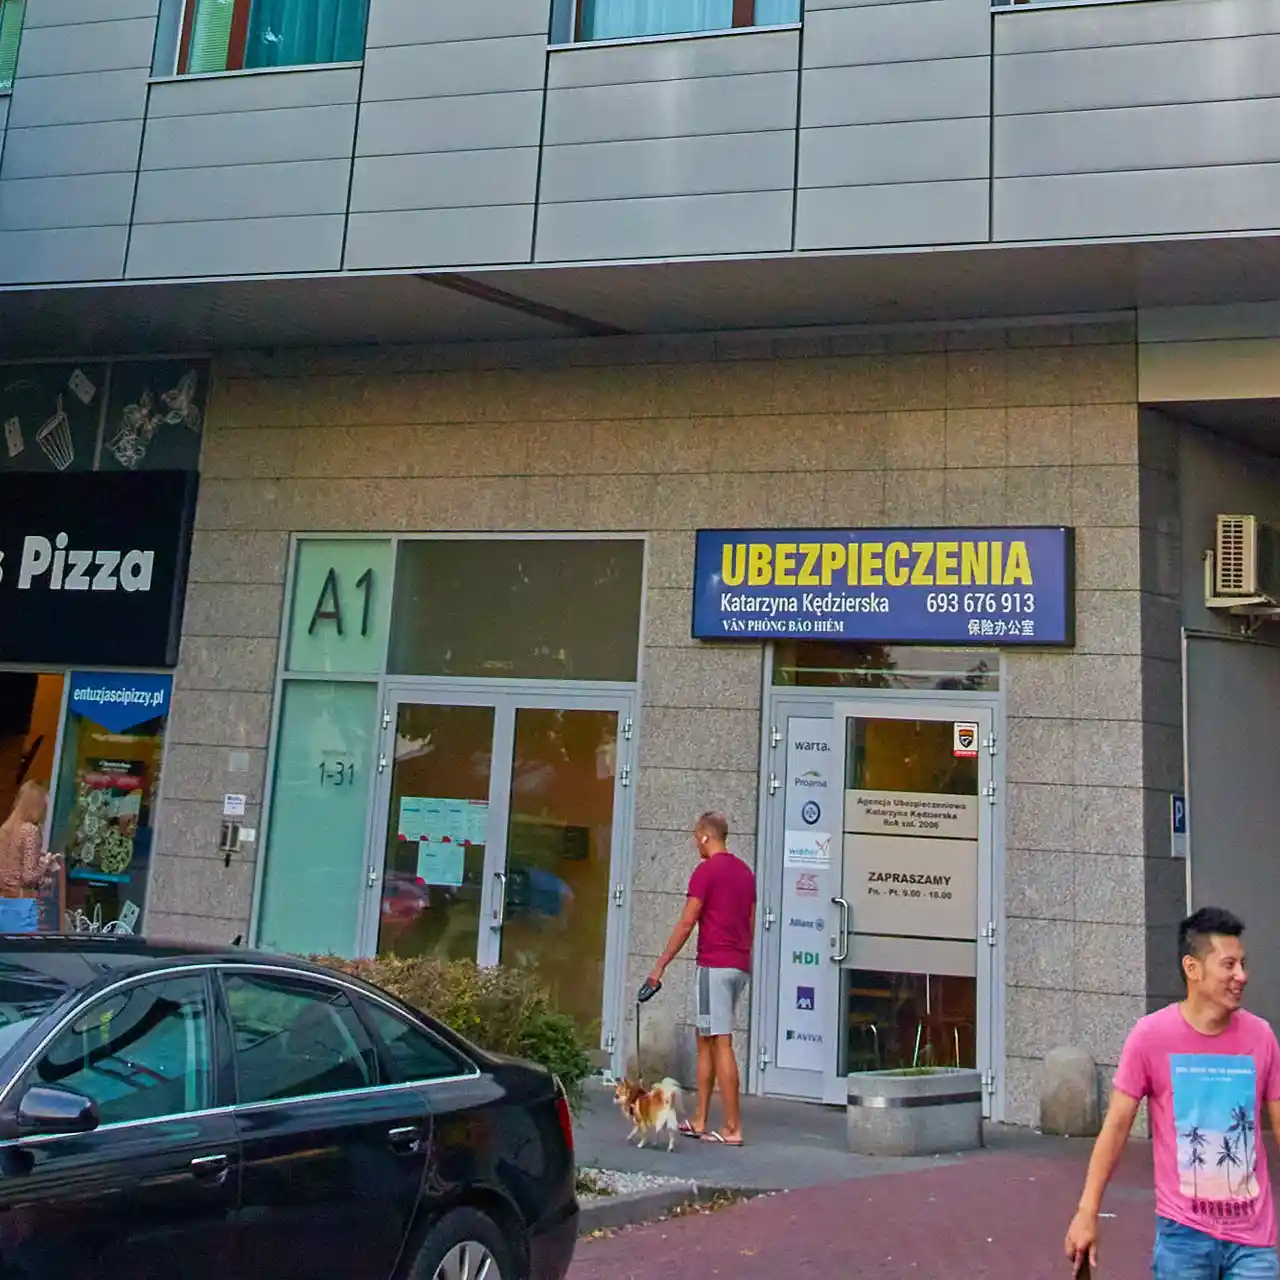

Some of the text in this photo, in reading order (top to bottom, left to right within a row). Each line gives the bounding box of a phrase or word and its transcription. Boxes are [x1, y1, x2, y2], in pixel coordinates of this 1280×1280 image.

[17, 532, 155, 591] Pizza
[722, 541, 1033, 586] UBEZPIECZENIA
[308, 566, 373, 637] A1
[720, 592, 1035, 616] Katarzyna Kędzierska 693 676 913
[968, 619, 1035, 636] 保险办公室
[73, 687, 164, 707] entuzjascipizzy.pl
[319, 761, 355, 788] 1-31
[857, 797, 967, 810] Agencja Ubezpieczeniowa
[865, 808, 958, 820] Katarzyna Kędzierska
[868, 871, 952, 886] ZAPRASZAMY
[792, 951, 820, 966] HDI
[796, 1033, 823, 1043] AVIVA
